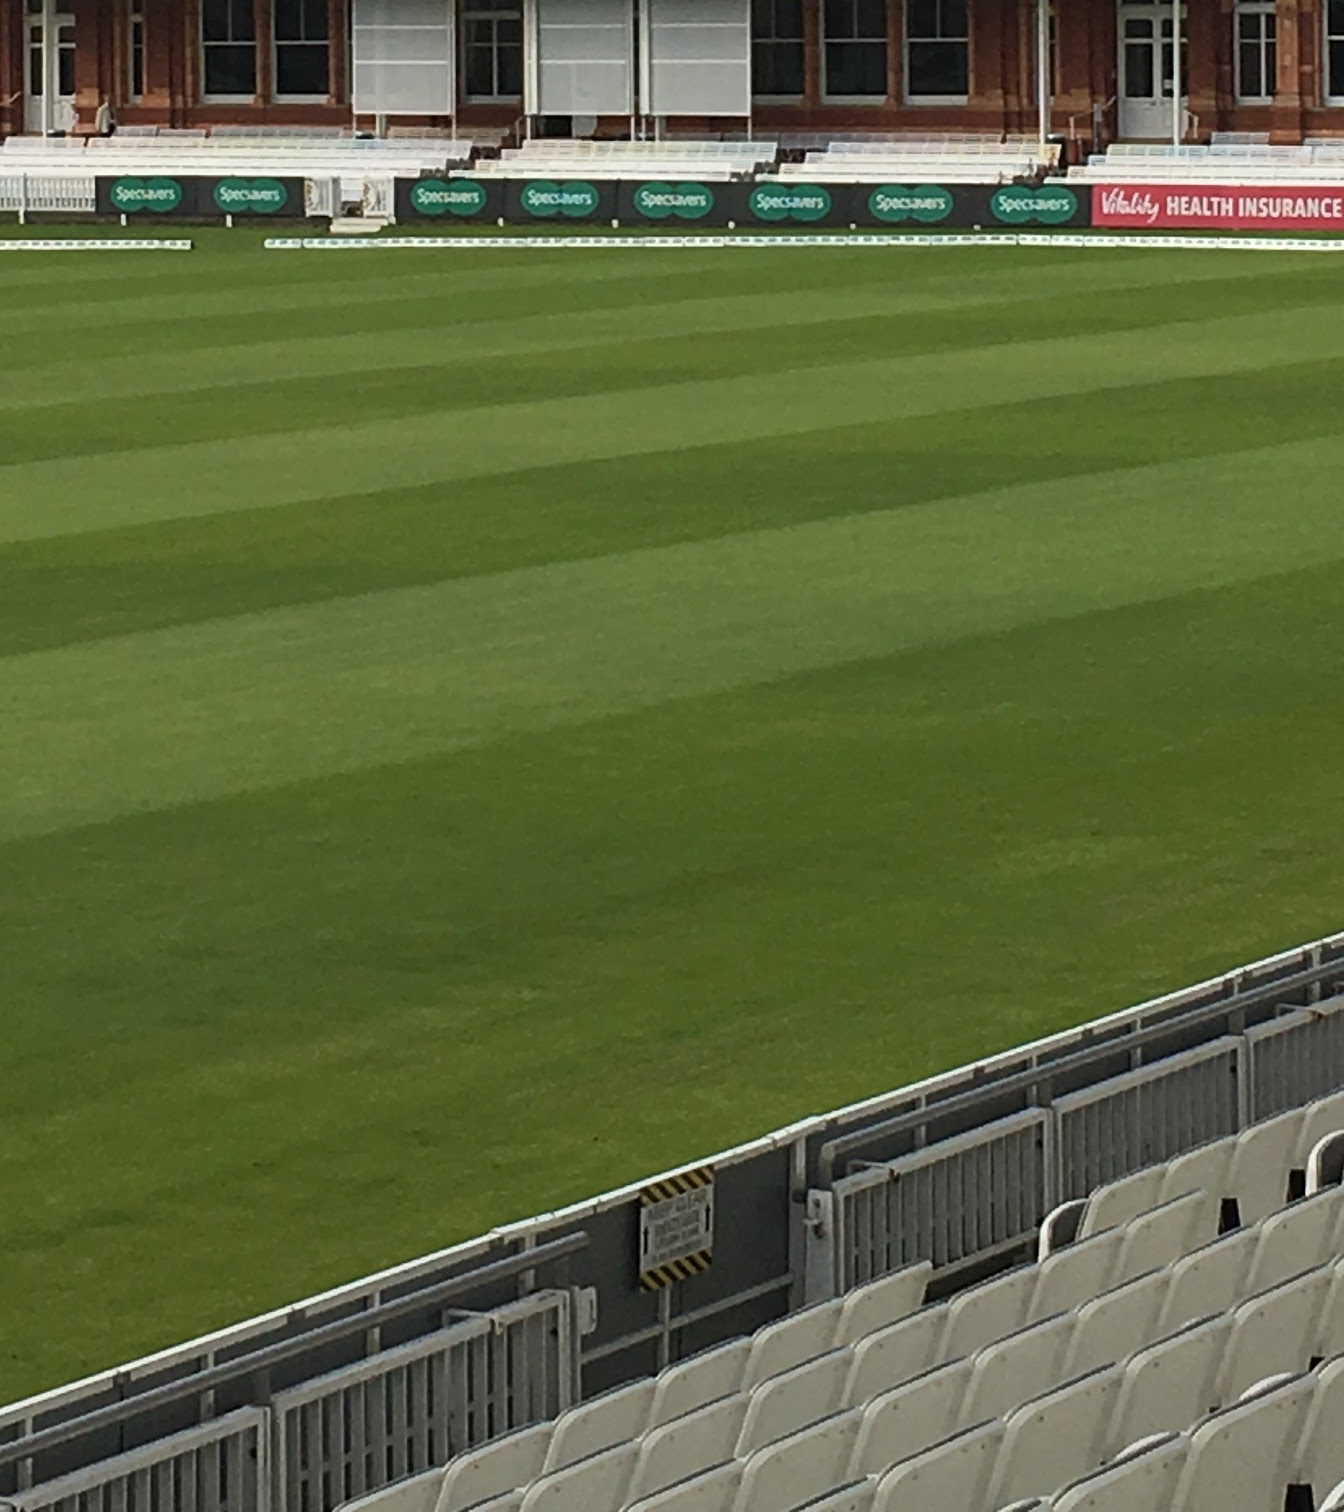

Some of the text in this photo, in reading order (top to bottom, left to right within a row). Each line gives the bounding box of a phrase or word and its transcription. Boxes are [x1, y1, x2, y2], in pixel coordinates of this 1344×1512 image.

[116, 185, 175, 201] Specsavers
[220, 186, 280, 202] Specsavers
[417, 189, 479, 204] Specsavers
[528, 189, 592, 205] Specsavers
[640, 190, 706, 207] Specsavers
[757, 193, 824, 210] Specsavers
[875, 194, 946, 211] Specsavers
[998, 196, 1070, 213] Specsavers
[1102, 188, 1343, 224] Vitality HEALTH INSURANCE
